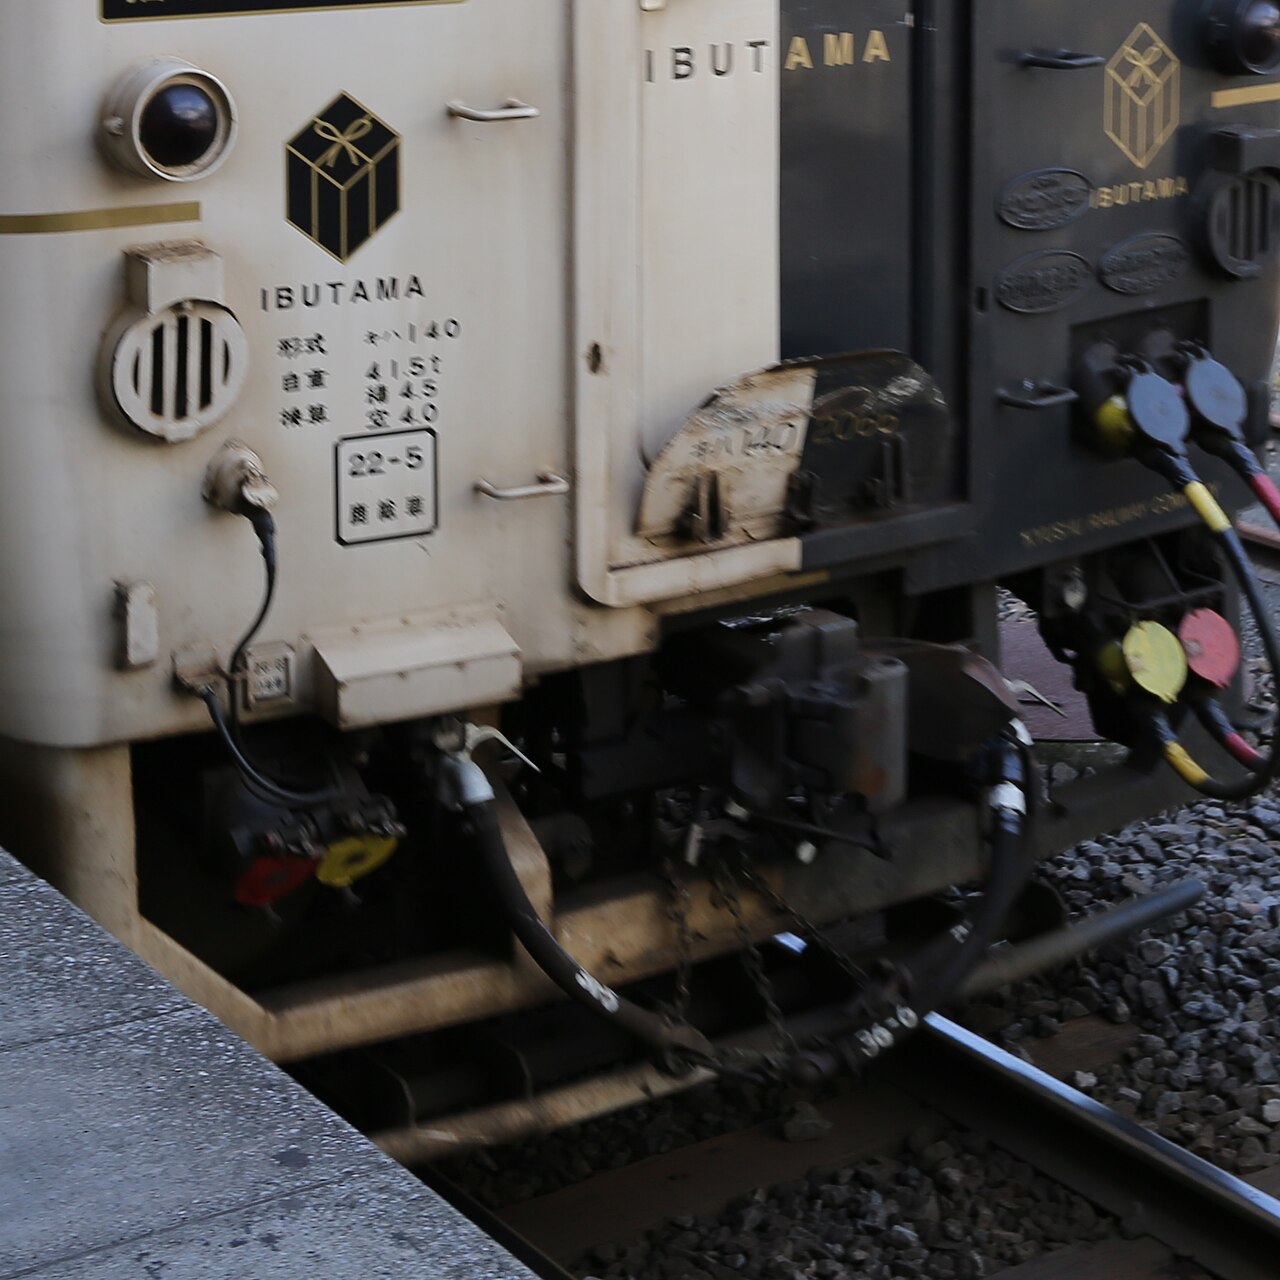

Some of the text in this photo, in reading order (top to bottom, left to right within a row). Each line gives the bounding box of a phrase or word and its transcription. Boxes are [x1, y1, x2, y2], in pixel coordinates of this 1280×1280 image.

[1089, 176, 1189, 209] IBUTAMA
[260, 274, 427, 313] IBUTAMA
[348, 445, 426, 477] 22-5
